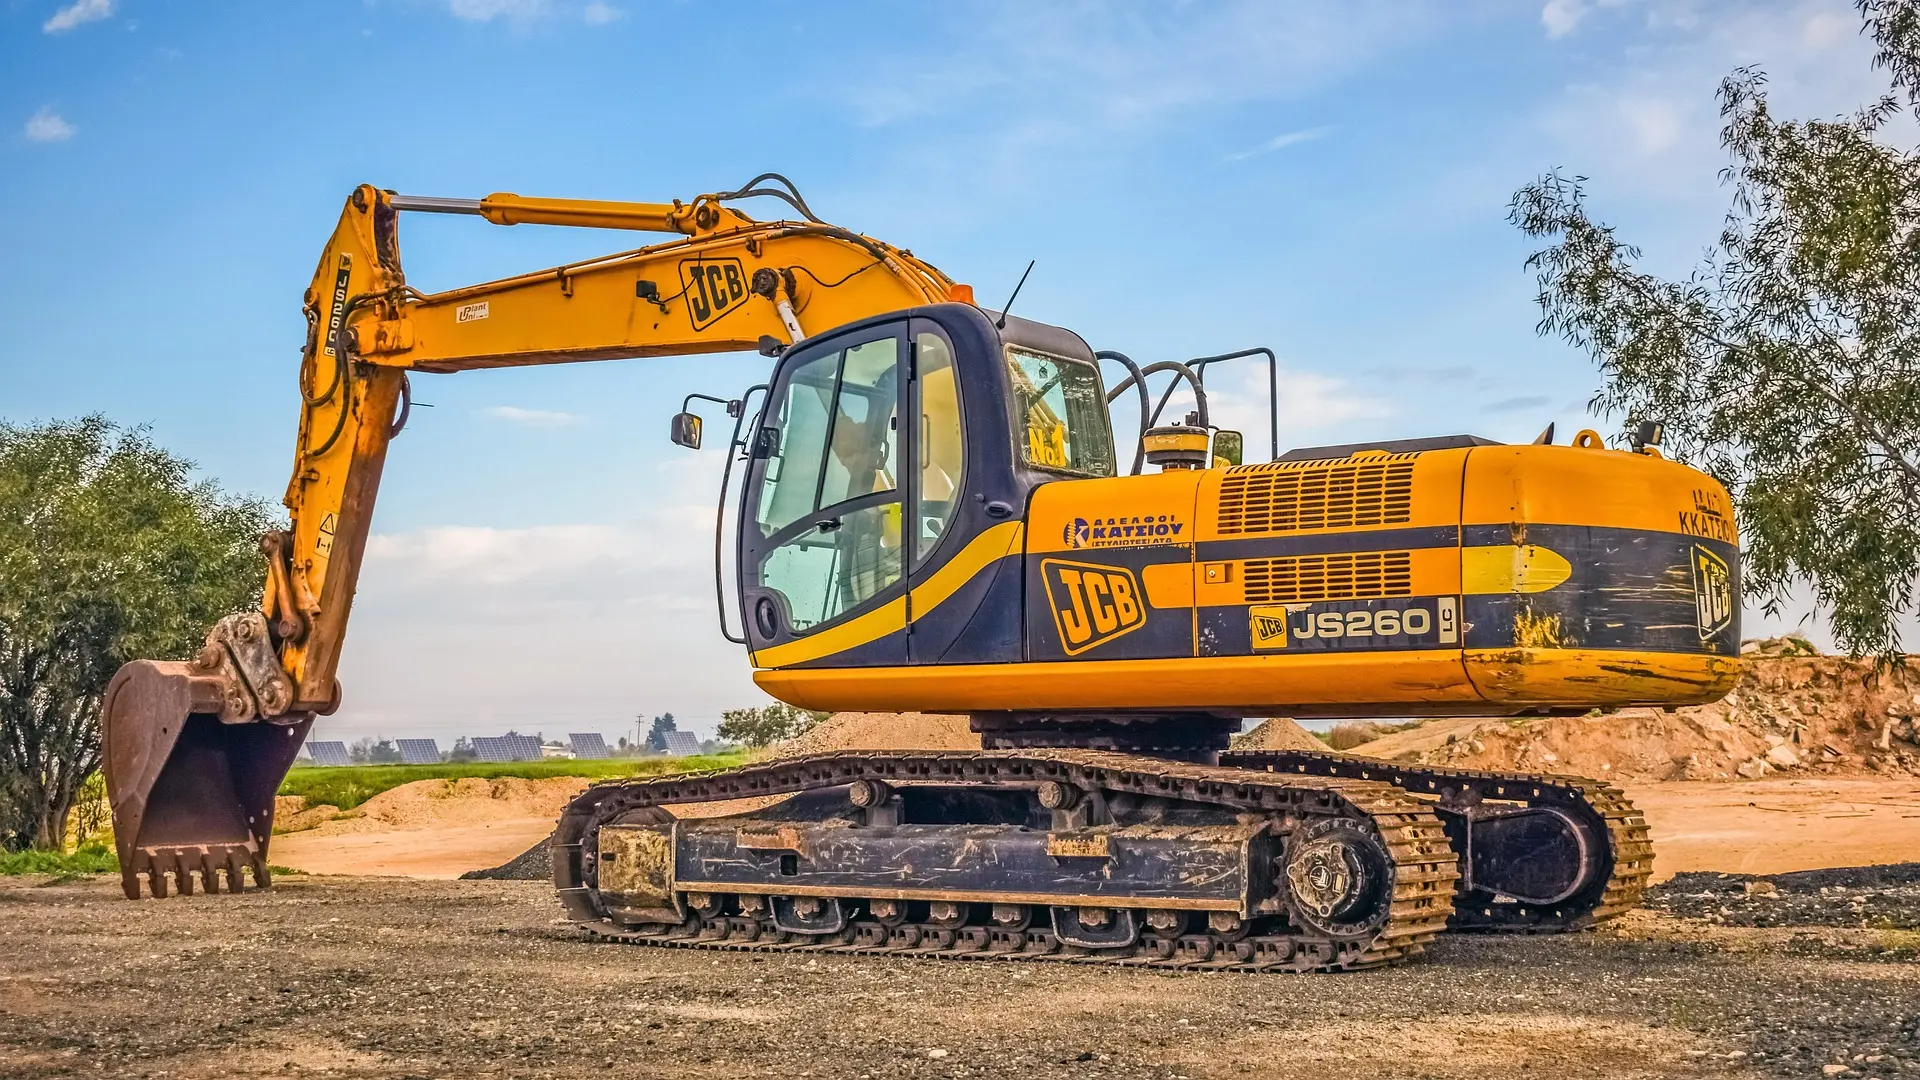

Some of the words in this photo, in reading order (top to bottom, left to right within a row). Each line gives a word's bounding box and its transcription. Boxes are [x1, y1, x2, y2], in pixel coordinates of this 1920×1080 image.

[689, 264, 743, 322] JCB
[1093, 523, 1183, 539] ΚΑΤΣΙΟΥ
[1059, 569, 1138, 643] JCB
[1260, 618, 1283, 638] JCB
[1293, 608, 1431, 639] JS260
[1443, 608, 1453, 632] LC
